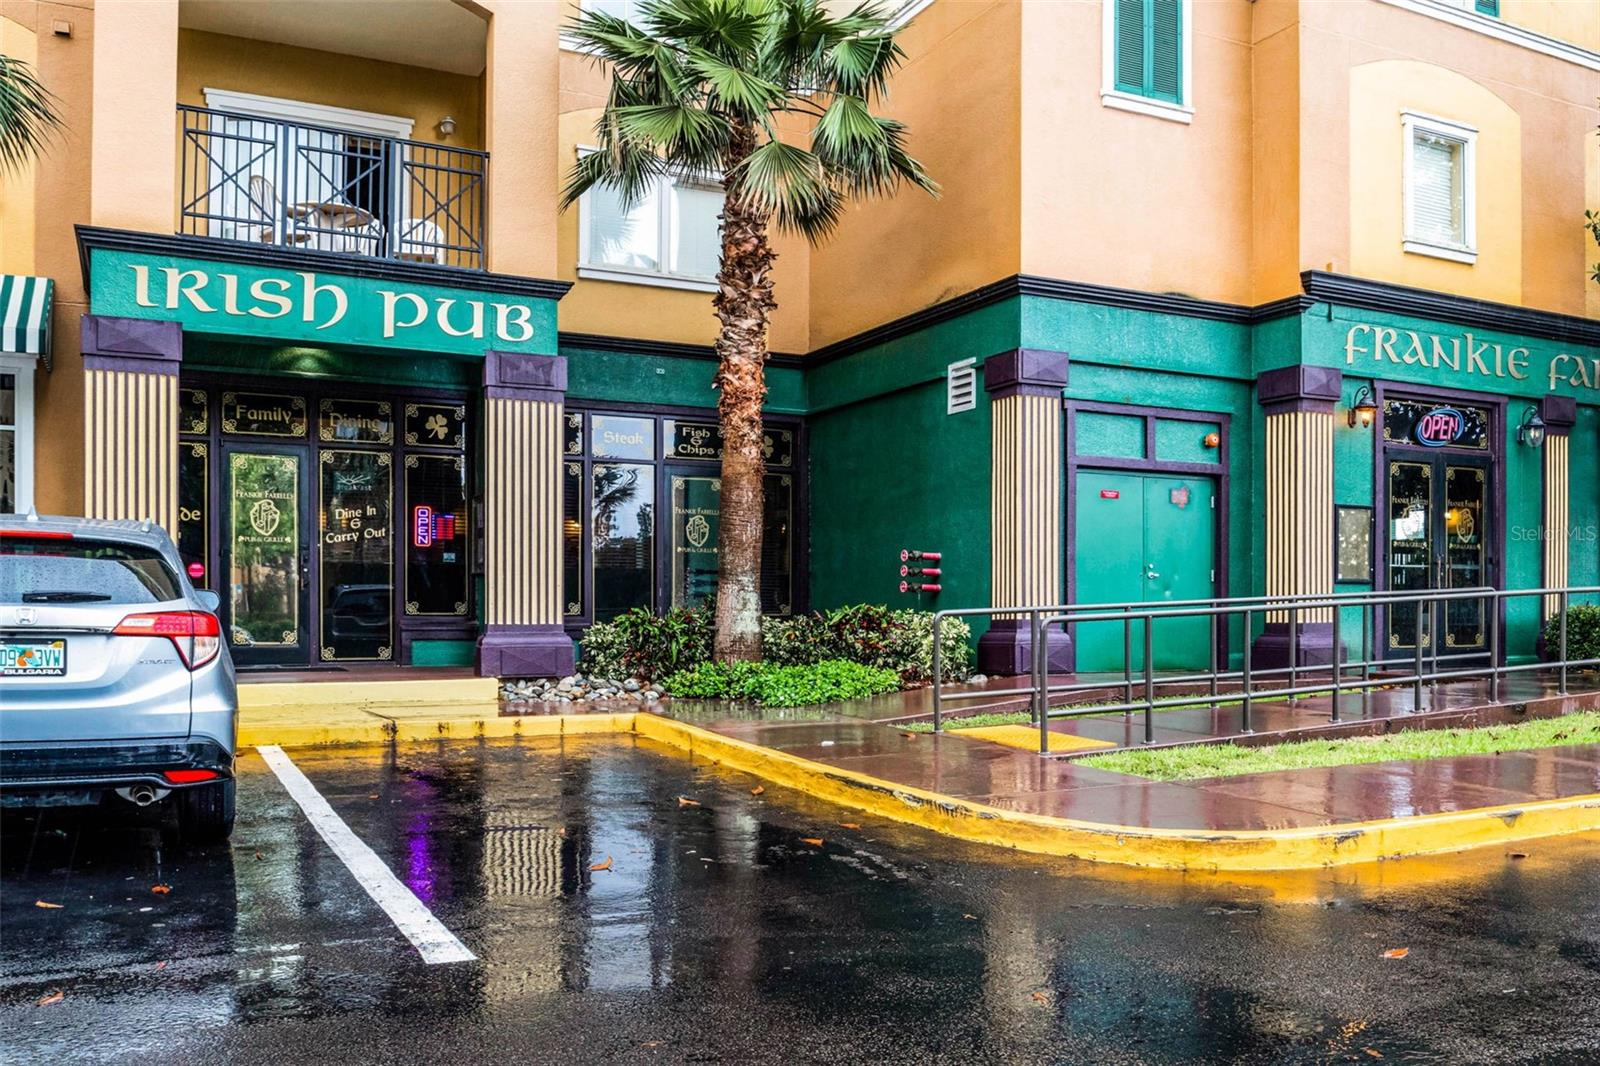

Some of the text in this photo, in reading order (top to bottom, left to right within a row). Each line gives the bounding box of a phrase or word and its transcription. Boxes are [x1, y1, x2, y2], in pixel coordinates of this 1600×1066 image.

[126, 264, 535, 342] IRISH PUB
[1343, 324, 1530, 379] FRANKIE
[236, 404, 292, 424] Family
[329, 412, 382, 432] Dining
[682, 426, 711, 439] Fish
[1421, 414, 1459, 440] OPEN
[603, 430, 644, 445] Steak
[678, 443, 715, 456] Chips
[335, 505, 377, 520] Dine In
[325, 528, 386, 544] Carry Out
[417, 508, 429, 544] OPEN
